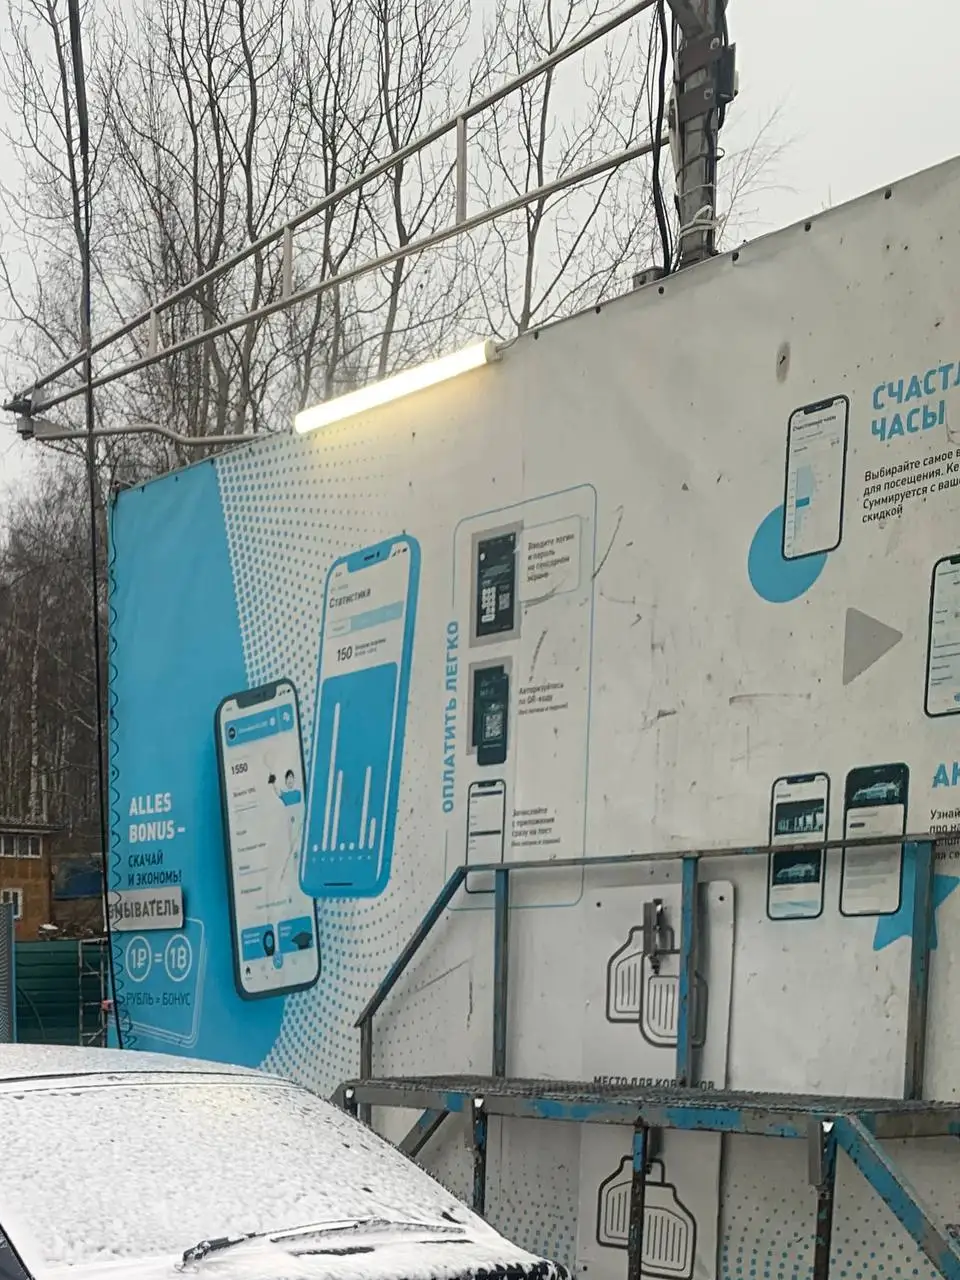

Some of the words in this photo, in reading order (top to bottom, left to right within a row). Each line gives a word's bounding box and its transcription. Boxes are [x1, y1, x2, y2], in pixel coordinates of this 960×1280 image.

[872, 400, 945, 441] ЧАСЫ
[865, 460, 920, 482] Выбирайте
[923, 450, 953, 466] самое
[863, 484, 881, 497] для
[884, 468, 943, 490] посещения.
[863, 486, 928, 510] Суммируется
[862, 504, 903, 523] скидкой
[337, 645, 353, 662] 150
[445, 620, 459, 692] ЛЕГКО
[442, 697, 457, 813] ОПЛАТИТЬ
[231, 762, 249, 775] 1550
[129, 792, 172, 816] ALLES
[128, 849, 163, 868] СКАЧАЙ
[136, 870, 182, 886] ЭКОНОМЬ!
[162, 992, 191, 1006] БОНУС
[593, 1075, 627, 1087] МЕСТО
